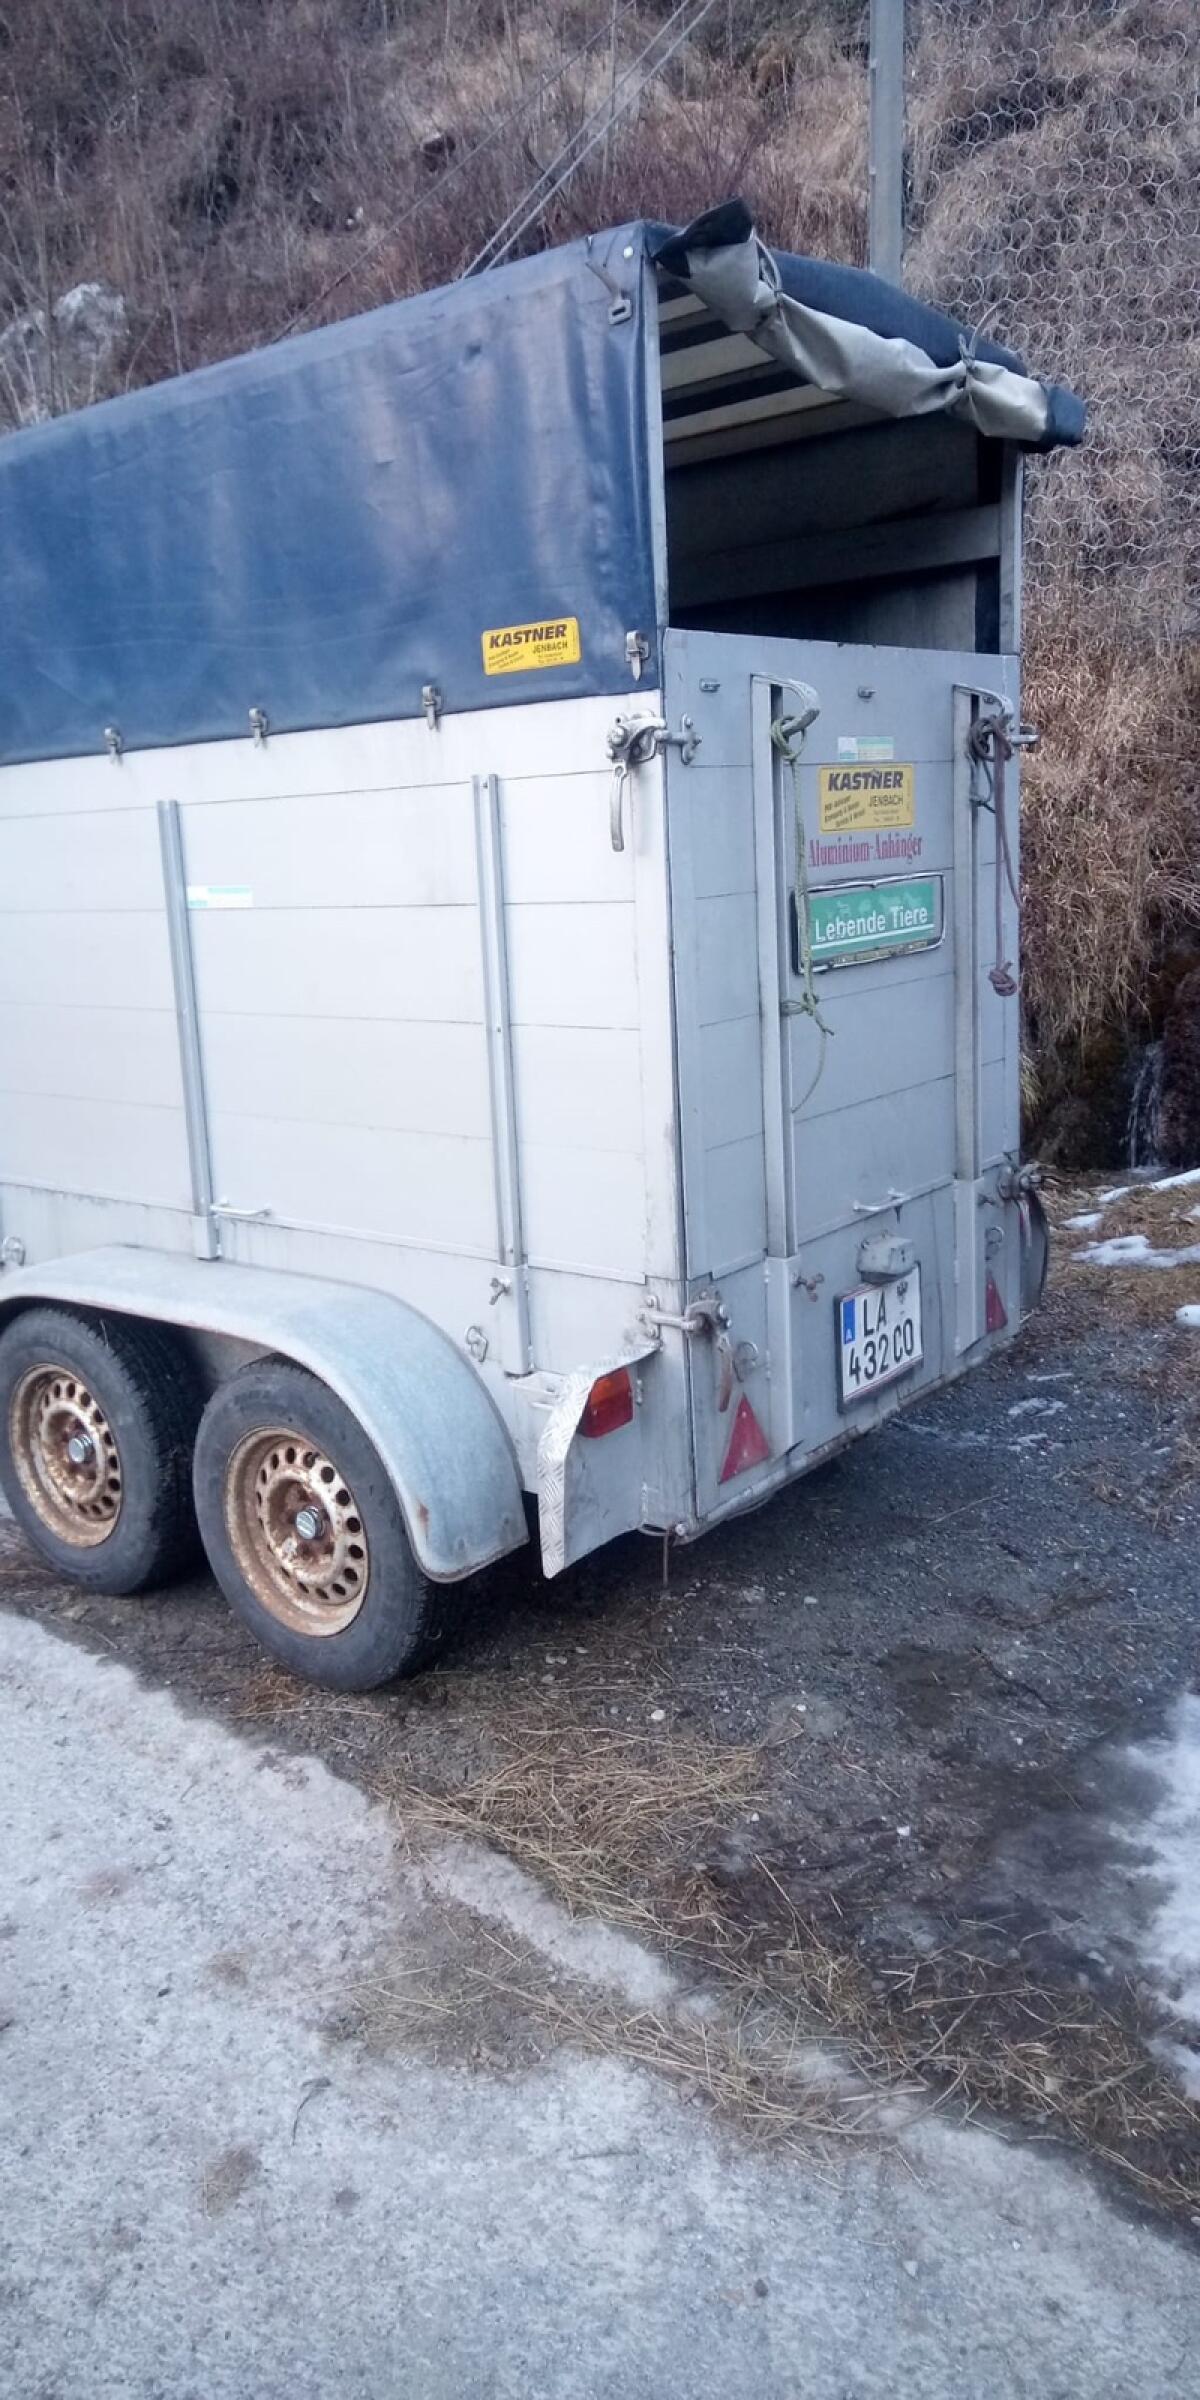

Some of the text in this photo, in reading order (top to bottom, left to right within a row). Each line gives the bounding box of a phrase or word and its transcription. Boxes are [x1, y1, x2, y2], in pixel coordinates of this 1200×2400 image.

[489, 623, 568, 649] KASTNER
[532, 640, 568, 654] JENBACH
[828, 770, 904, 791] KASTNER
[868, 793, 904, 807] JENBACH
[815, 904, 928, 943] Lebende Tiere
[863, 1289, 888, 1338] LA
